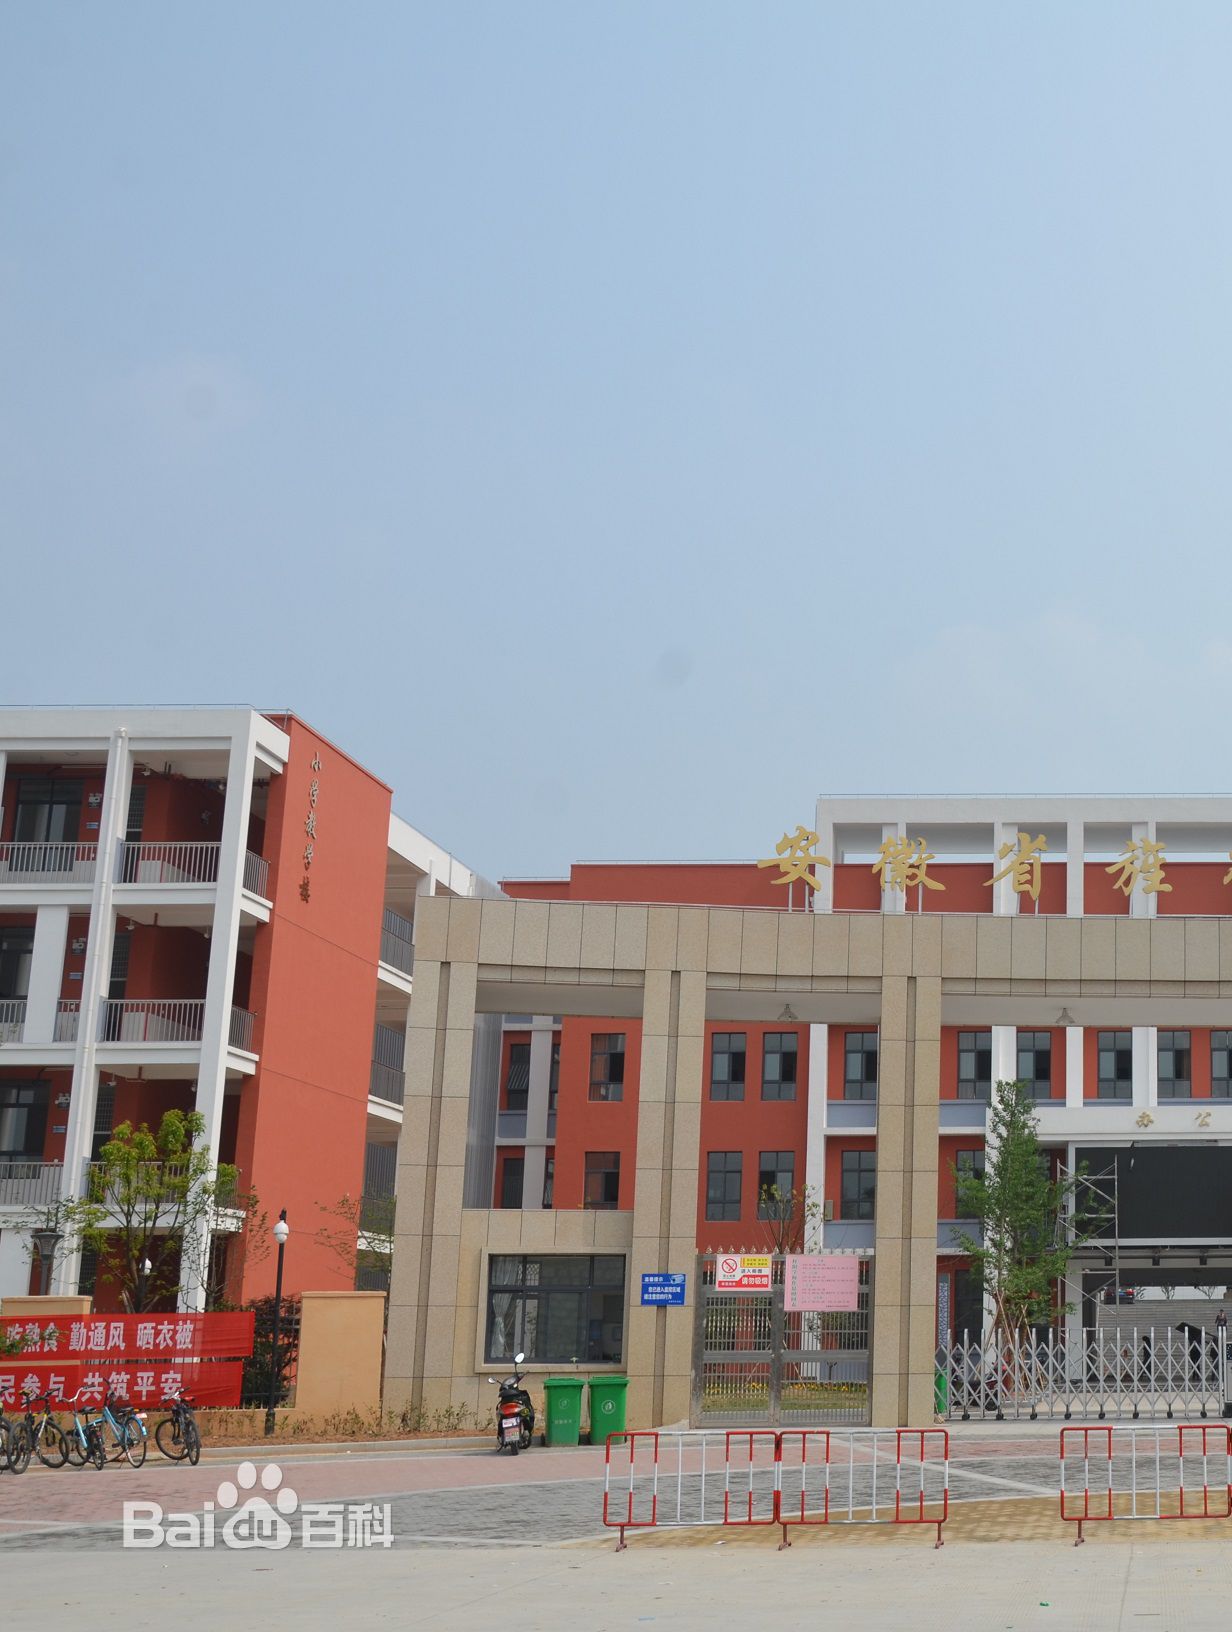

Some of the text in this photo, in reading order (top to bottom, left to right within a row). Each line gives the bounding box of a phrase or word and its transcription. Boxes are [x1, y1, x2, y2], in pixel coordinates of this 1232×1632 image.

[68, 1321, 126, 1352] 勤通风
[136, 1320, 194, 1351] 晒衣被
[81, 1370, 183, 1402] 共筑平安
